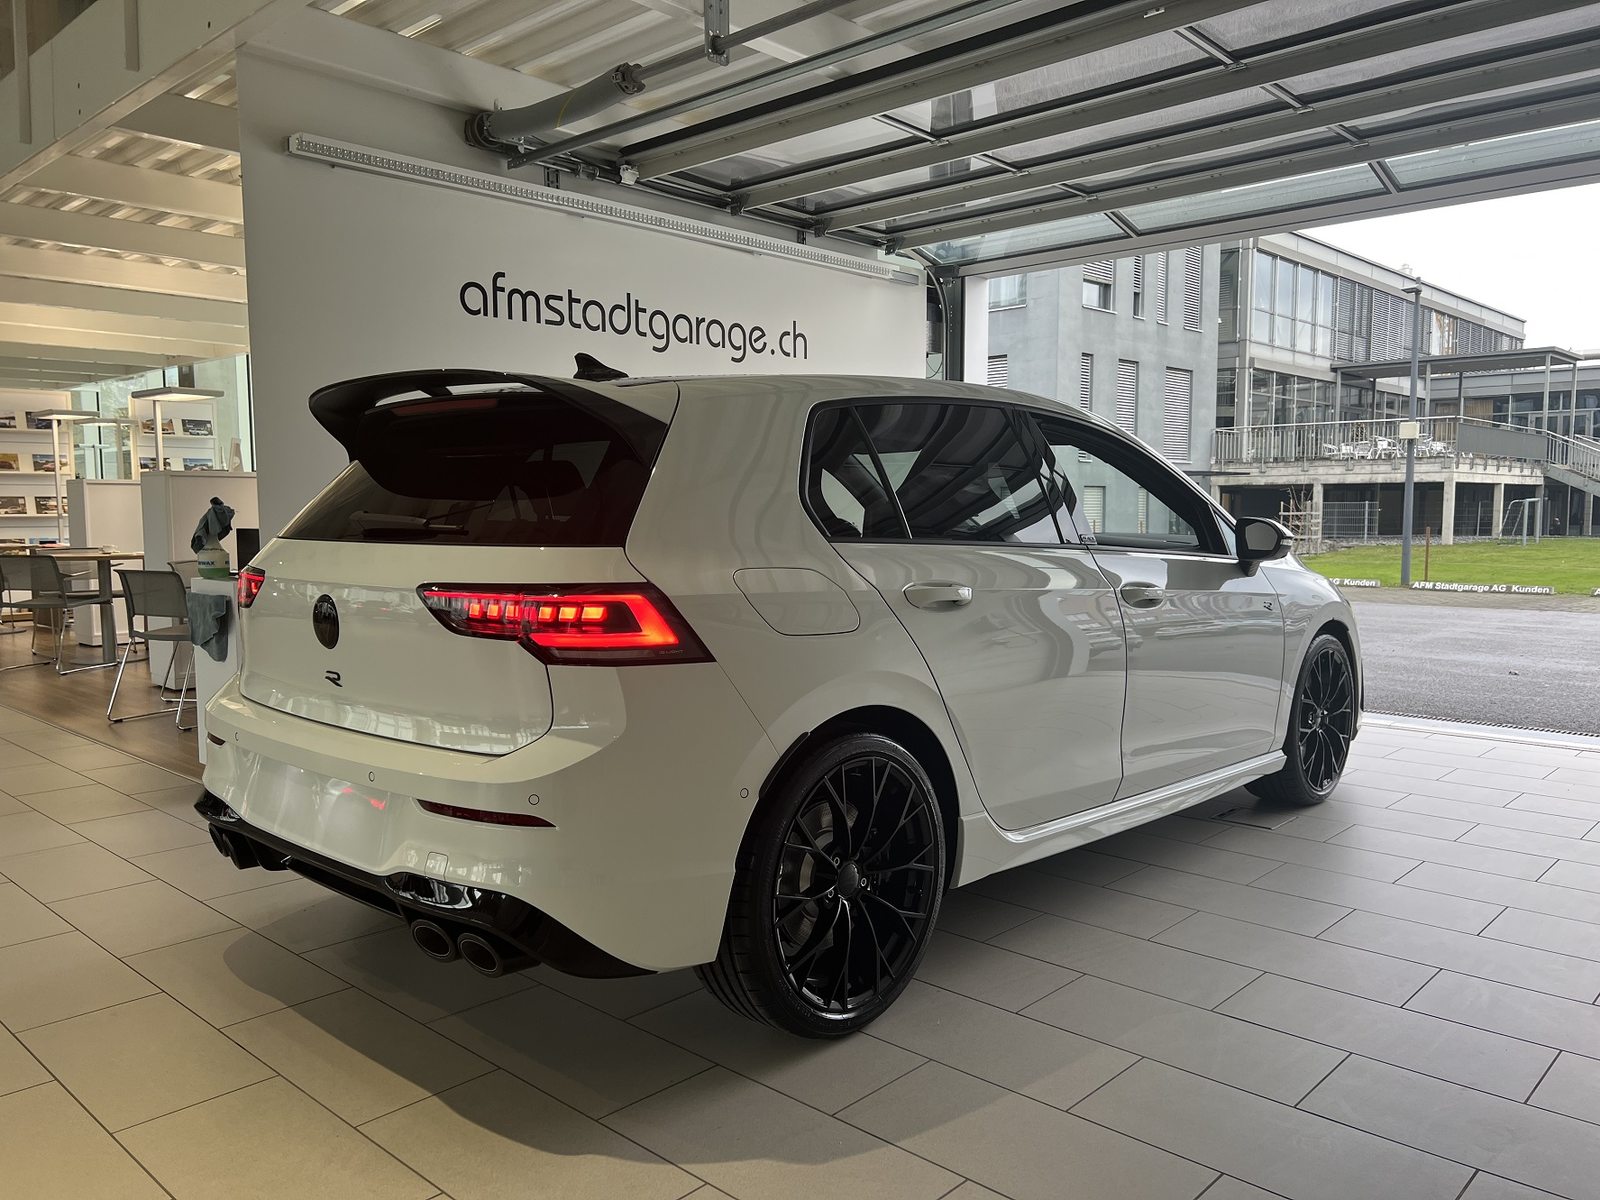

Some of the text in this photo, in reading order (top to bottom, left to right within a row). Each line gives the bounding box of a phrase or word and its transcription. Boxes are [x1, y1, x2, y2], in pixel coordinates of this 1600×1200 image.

[459, 271, 808, 363] afmstadtgarage.ch
[1343, 578, 1376, 587] Kunden
[1412, 581, 1550, 594] AFM Stadtgarage AG Kunden
